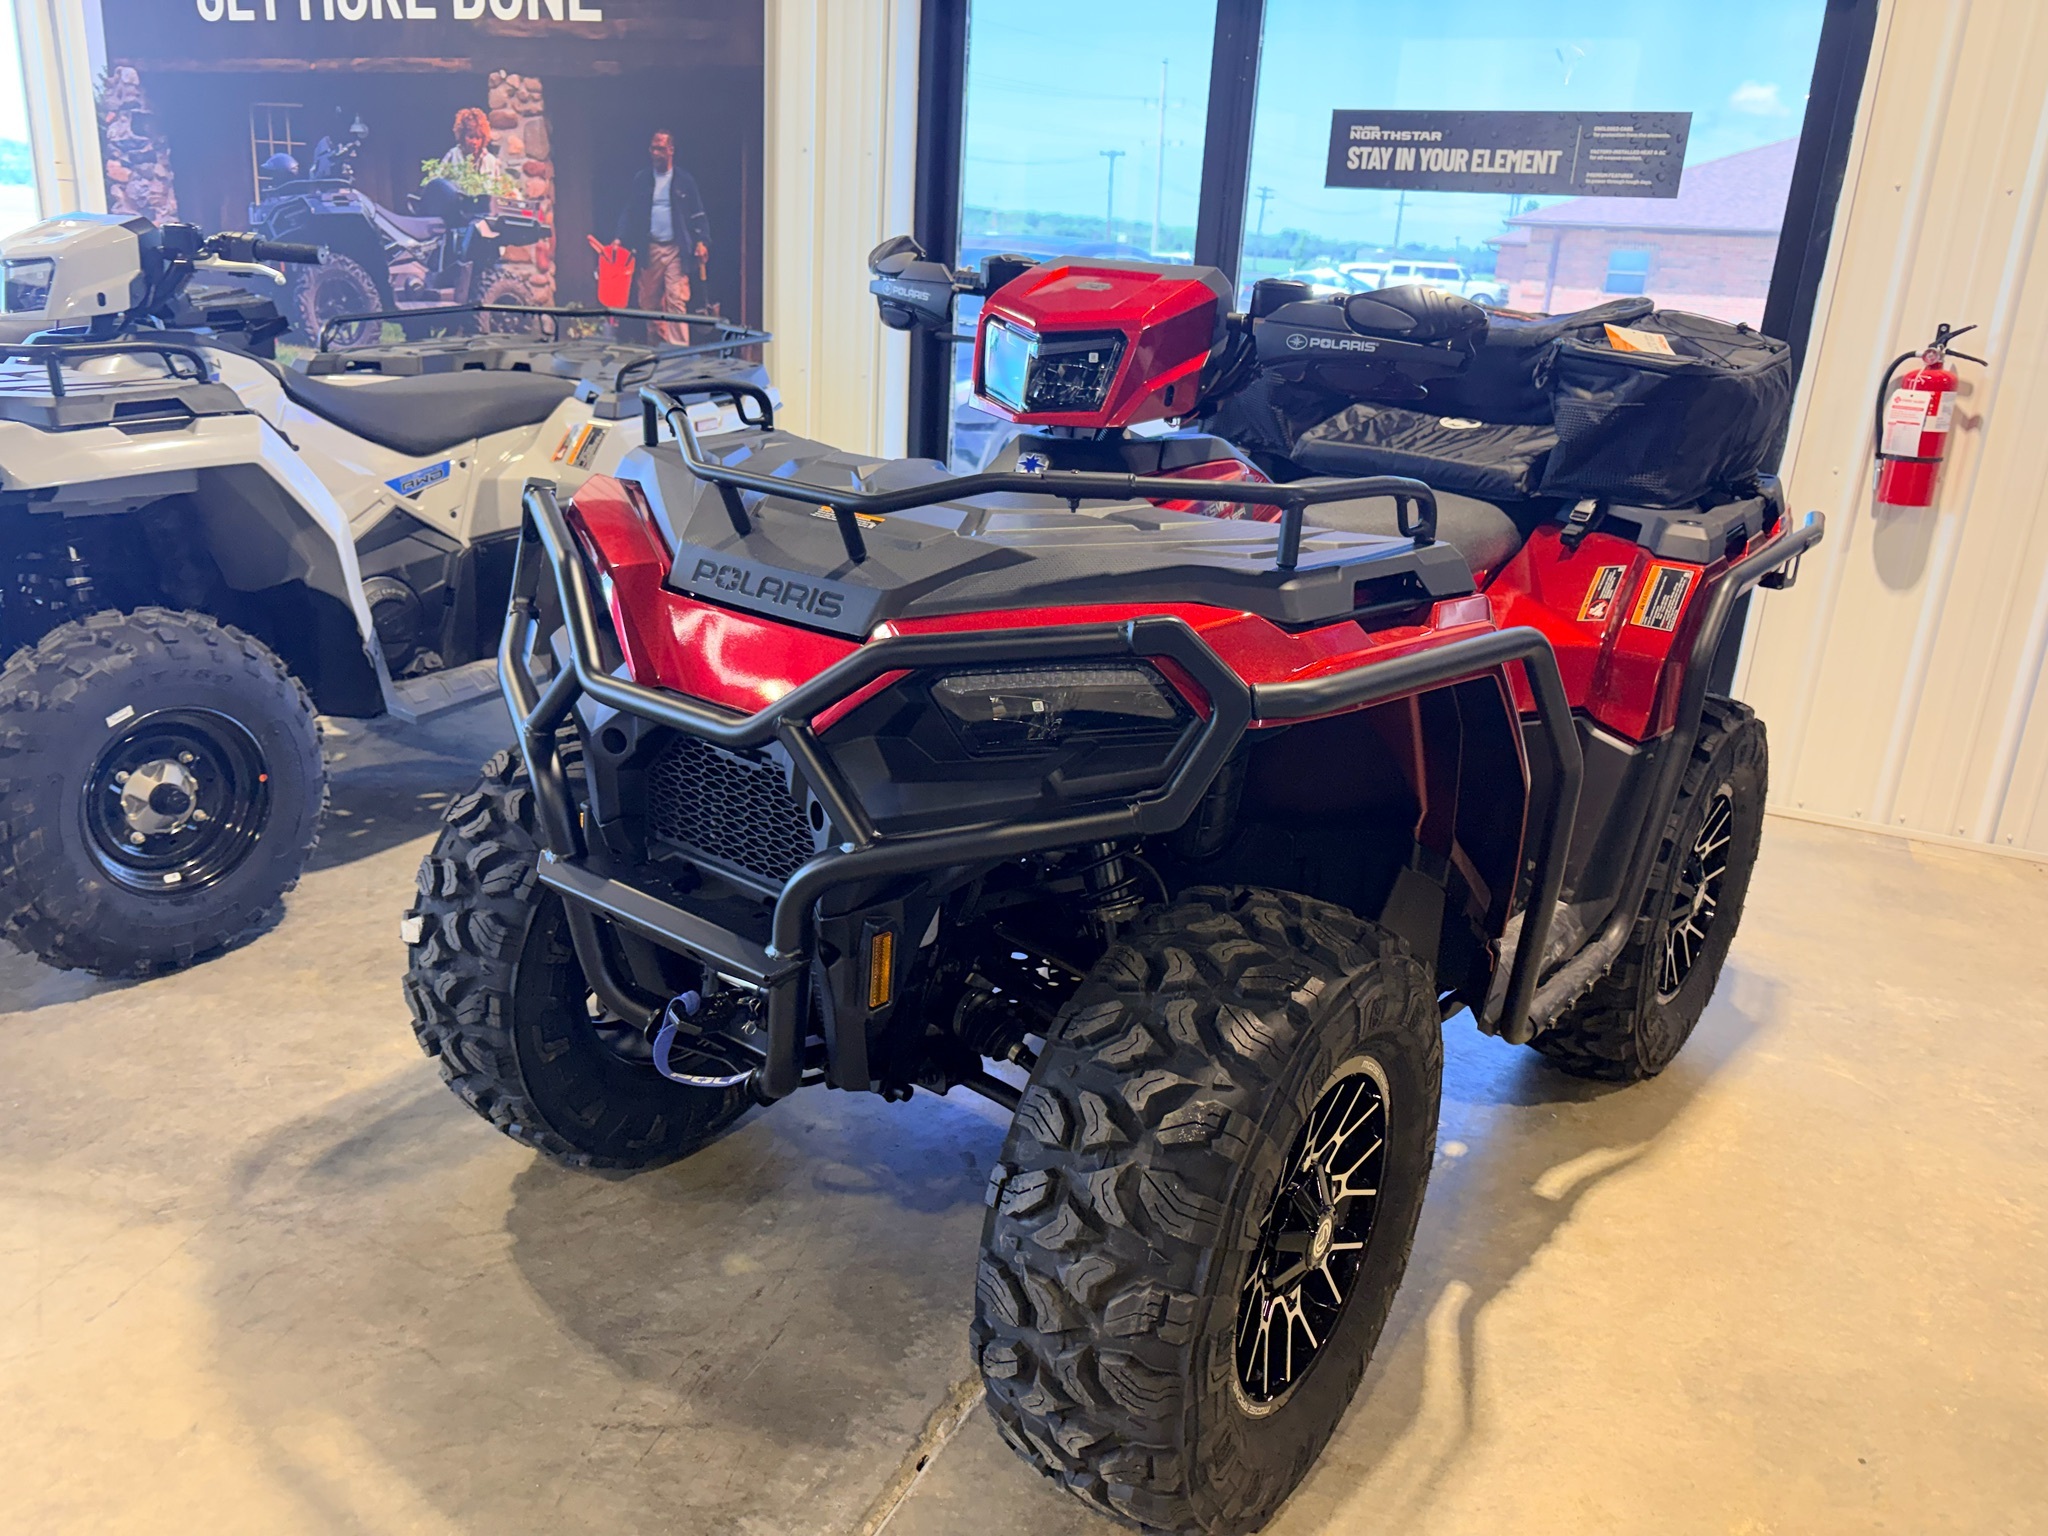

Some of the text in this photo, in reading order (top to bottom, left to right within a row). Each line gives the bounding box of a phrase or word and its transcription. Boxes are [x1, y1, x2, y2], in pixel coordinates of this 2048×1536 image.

[1350, 130, 1442, 141] NORTHSTAR
[1346, 146, 1563, 174] STAY IN YOUR ELEMENT
[893, 285, 930, 301] POLARIS
[1309, 337, 1376, 352] POLARIS
[402, 468, 443, 492] AWD
[691, 559, 845, 619] POLARIS
